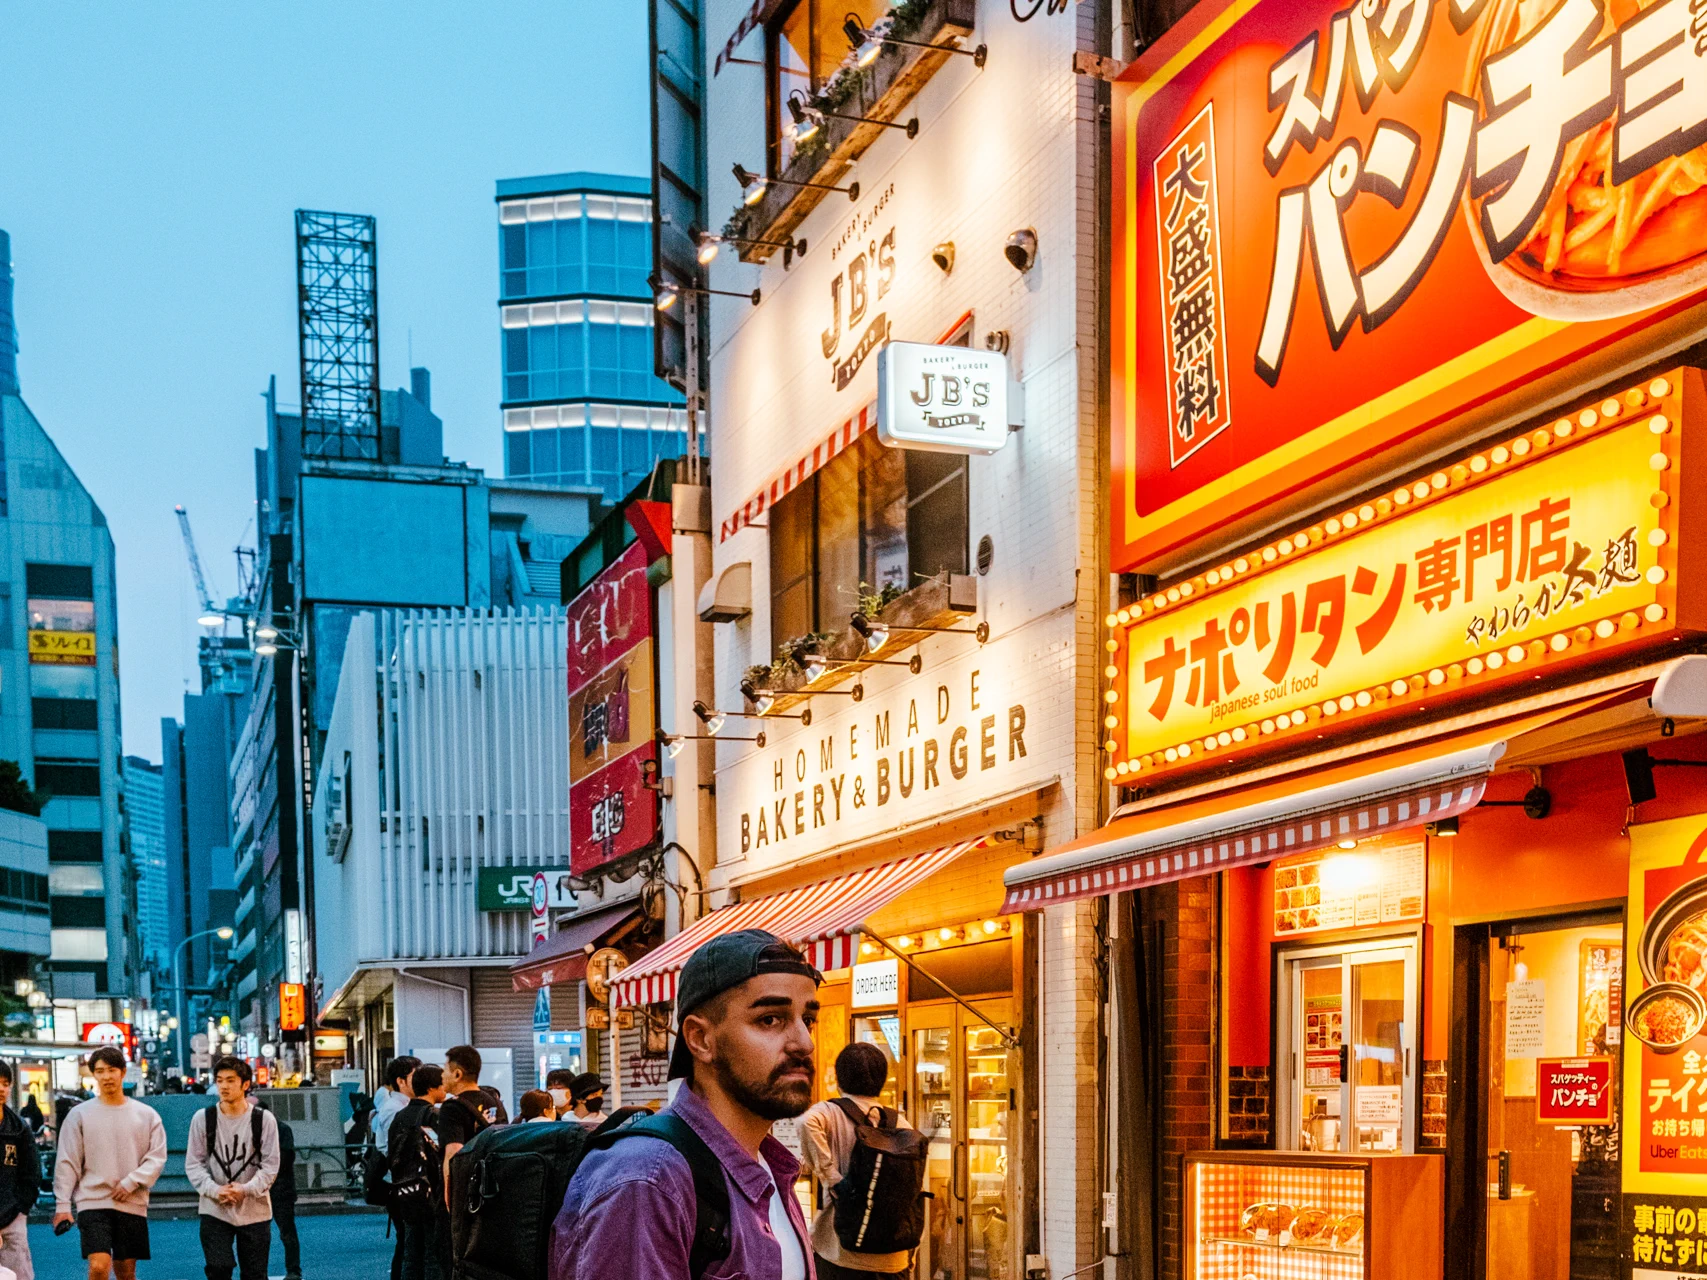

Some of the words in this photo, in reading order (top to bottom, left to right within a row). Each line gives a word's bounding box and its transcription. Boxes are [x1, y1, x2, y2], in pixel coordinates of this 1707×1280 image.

[1163, 141, 1218, 443] 大盛無料
[923, 356, 955, 364] BAKERY
[937, 415, 970, 427] TOKYO
[1144, 497, 1571, 722] ナポリタン専門店
[1210, 692, 1260, 724] japanese
[1263, 681, 1288, 703] soul
[1291, 670, 1320, 695] food
[774, 669, 981, 792] HOMEMADE
[856, 976, 878, 994] ORDER
[879, 974, 897, 992] HERE
[1682, 1049, 1707, 1075] 全
[1650, 1144, 1679, 1159] Uber
